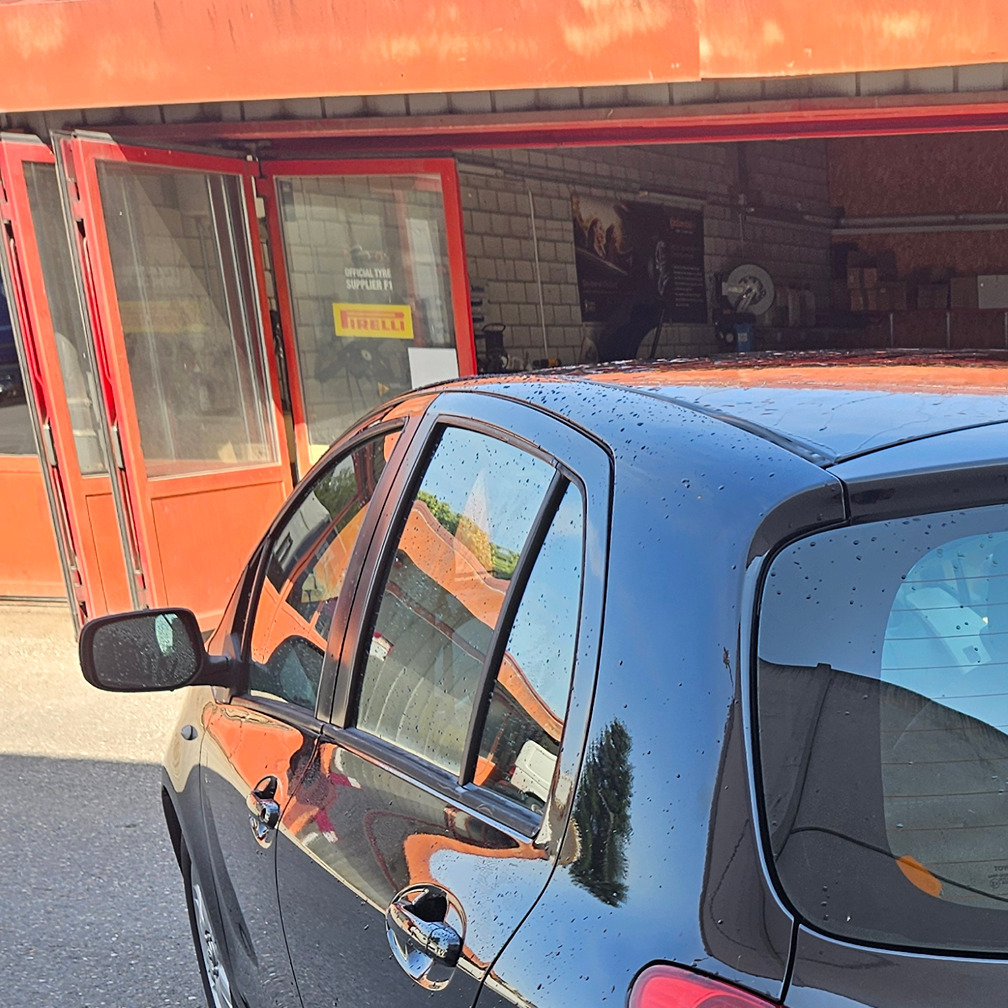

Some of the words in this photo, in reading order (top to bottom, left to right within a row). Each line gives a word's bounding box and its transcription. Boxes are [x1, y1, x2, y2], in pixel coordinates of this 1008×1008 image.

[344, 267, 374, 278] OFFICIAL
[374, 268, 392, 279] TYRE
[346, 279, 383, 291] SUPPLIER
[383, 279, 393, 291] F1
[340, 309, 405, 332] PIRELLI
